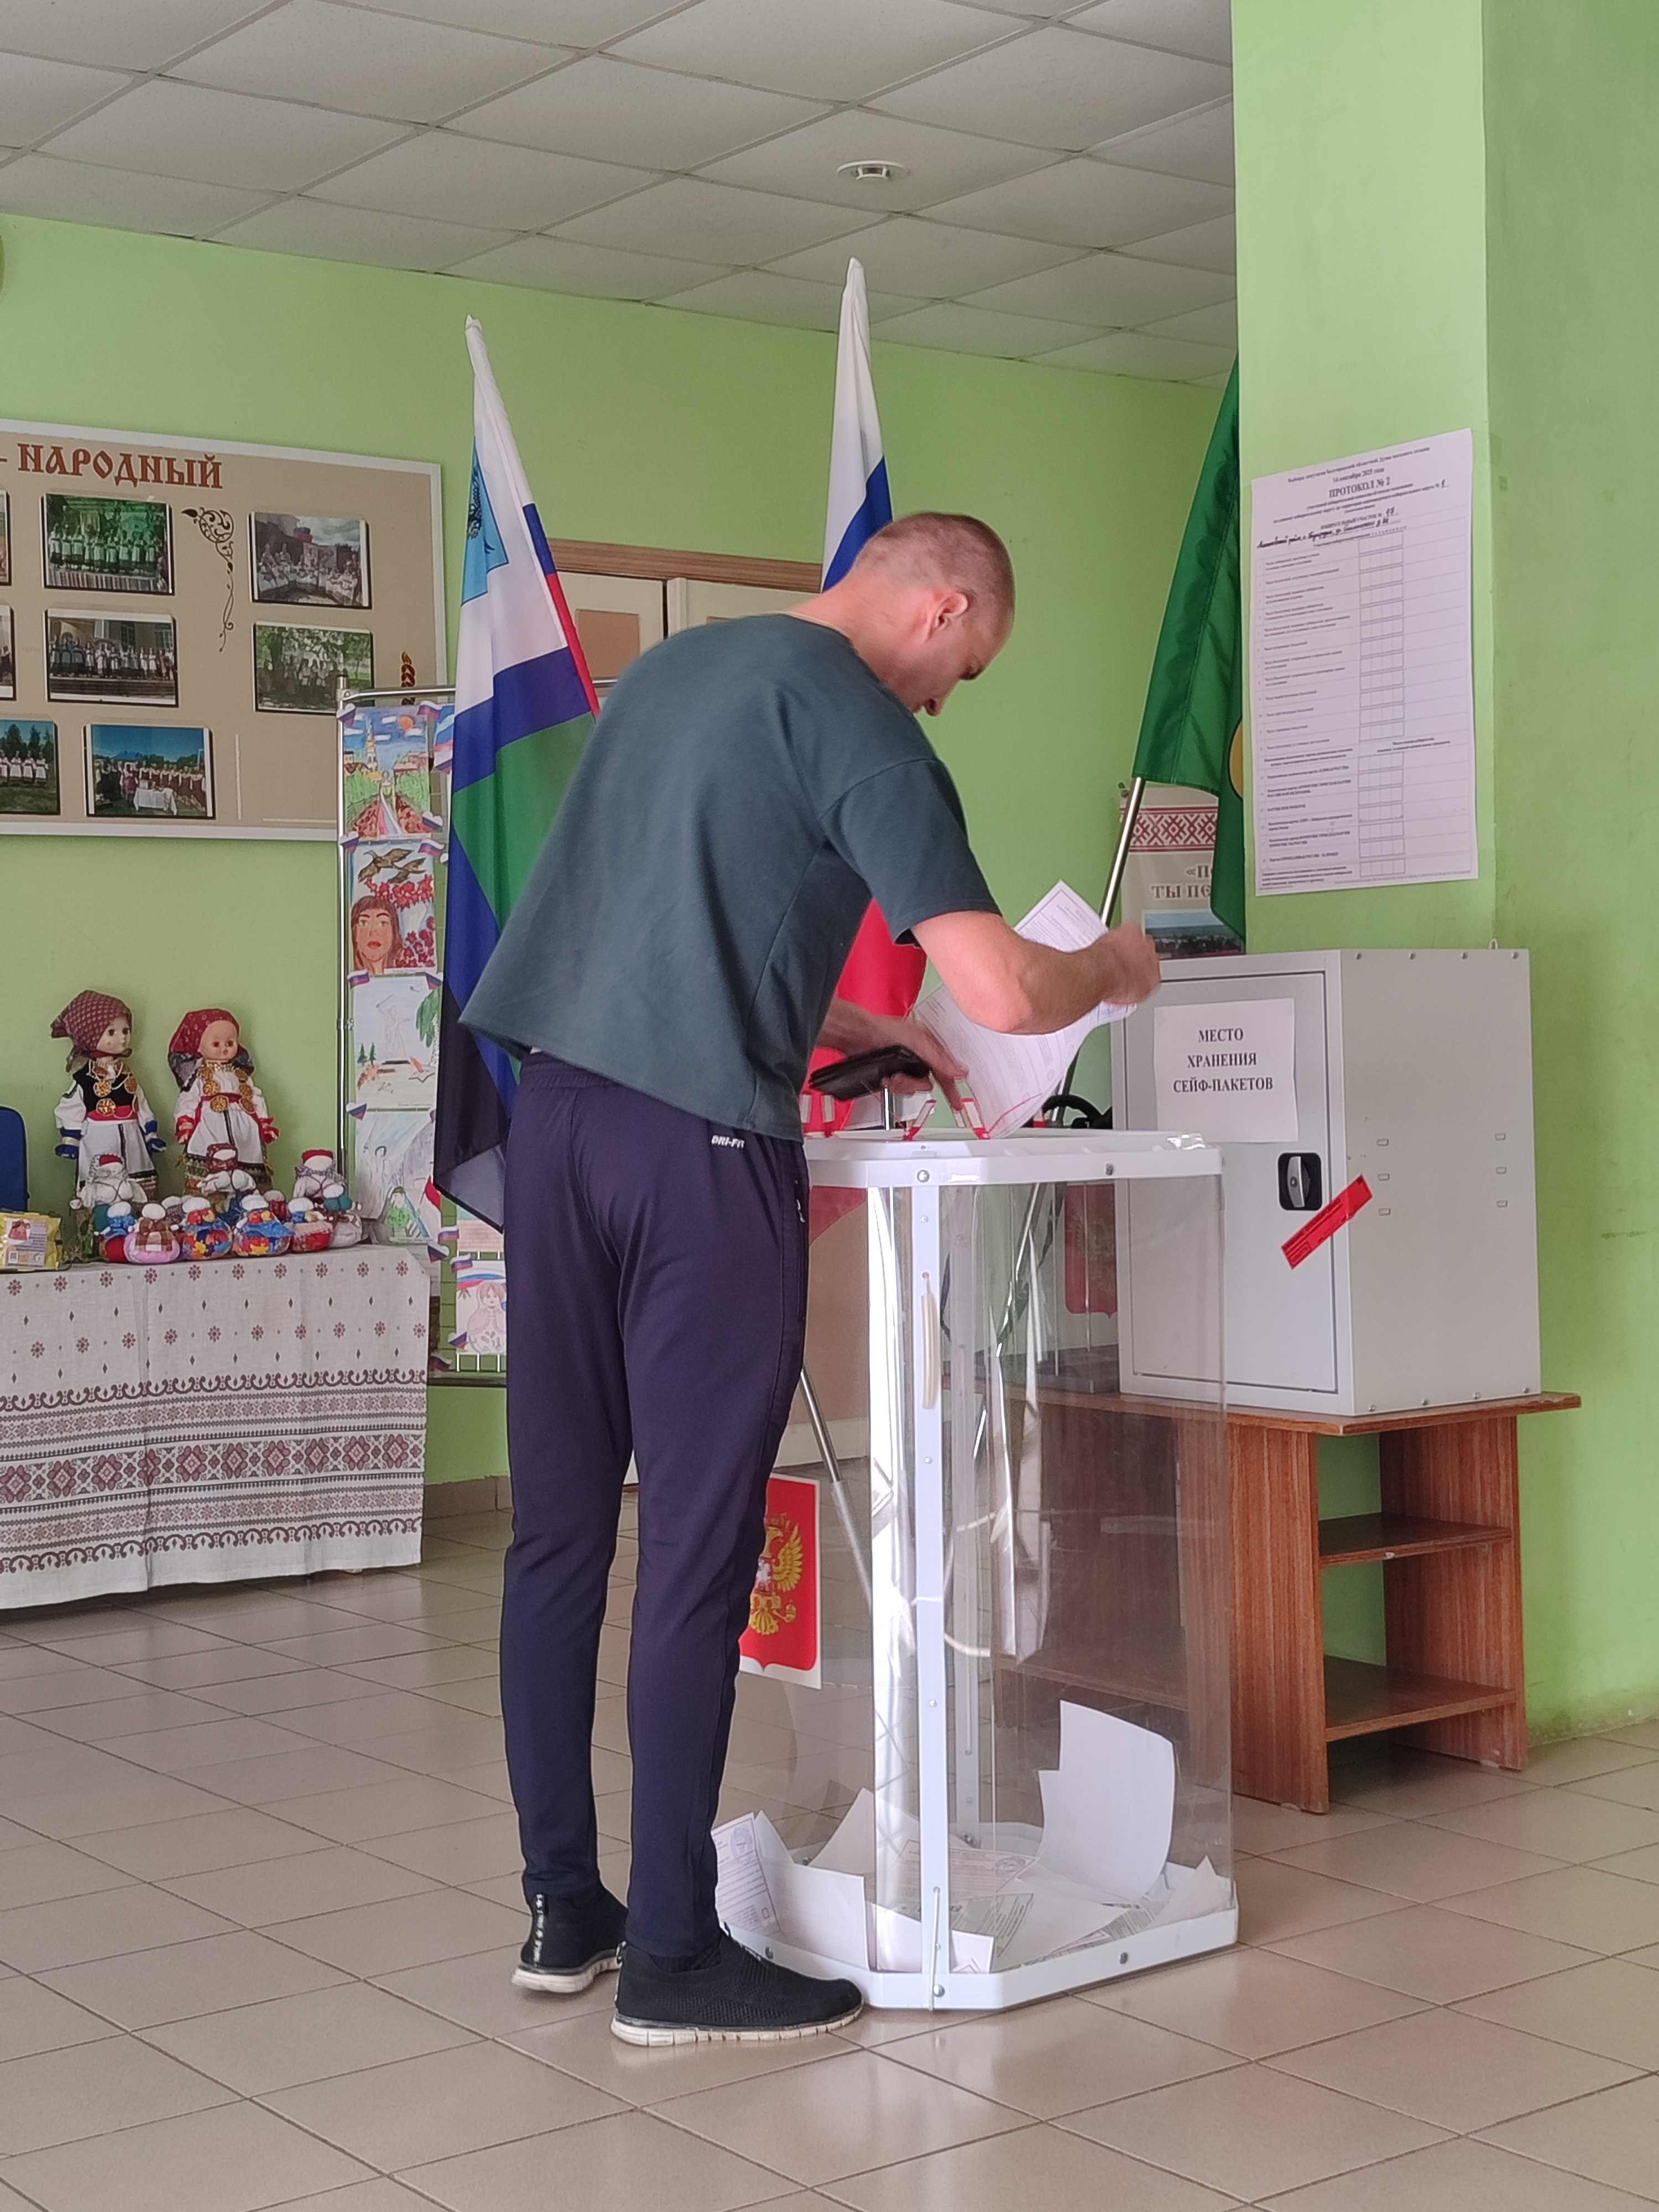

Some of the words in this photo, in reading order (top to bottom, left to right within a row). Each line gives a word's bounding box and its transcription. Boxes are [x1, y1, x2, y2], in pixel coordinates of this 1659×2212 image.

[17, 443, 223, 489] НАРОДНЫЙ
[1329, 480, 1375, 498] ПРОТОКОЛ
[1151, 885, 1181, 899] ТЫ
[1198, 1028, 1244, 1042] МЕСТО
[1187, 1052, 1257, 1068] ХРАНЕНИЯ
[1173, 1077, 1274, 1093] СЕЙФ-ПАКЕТОВ
